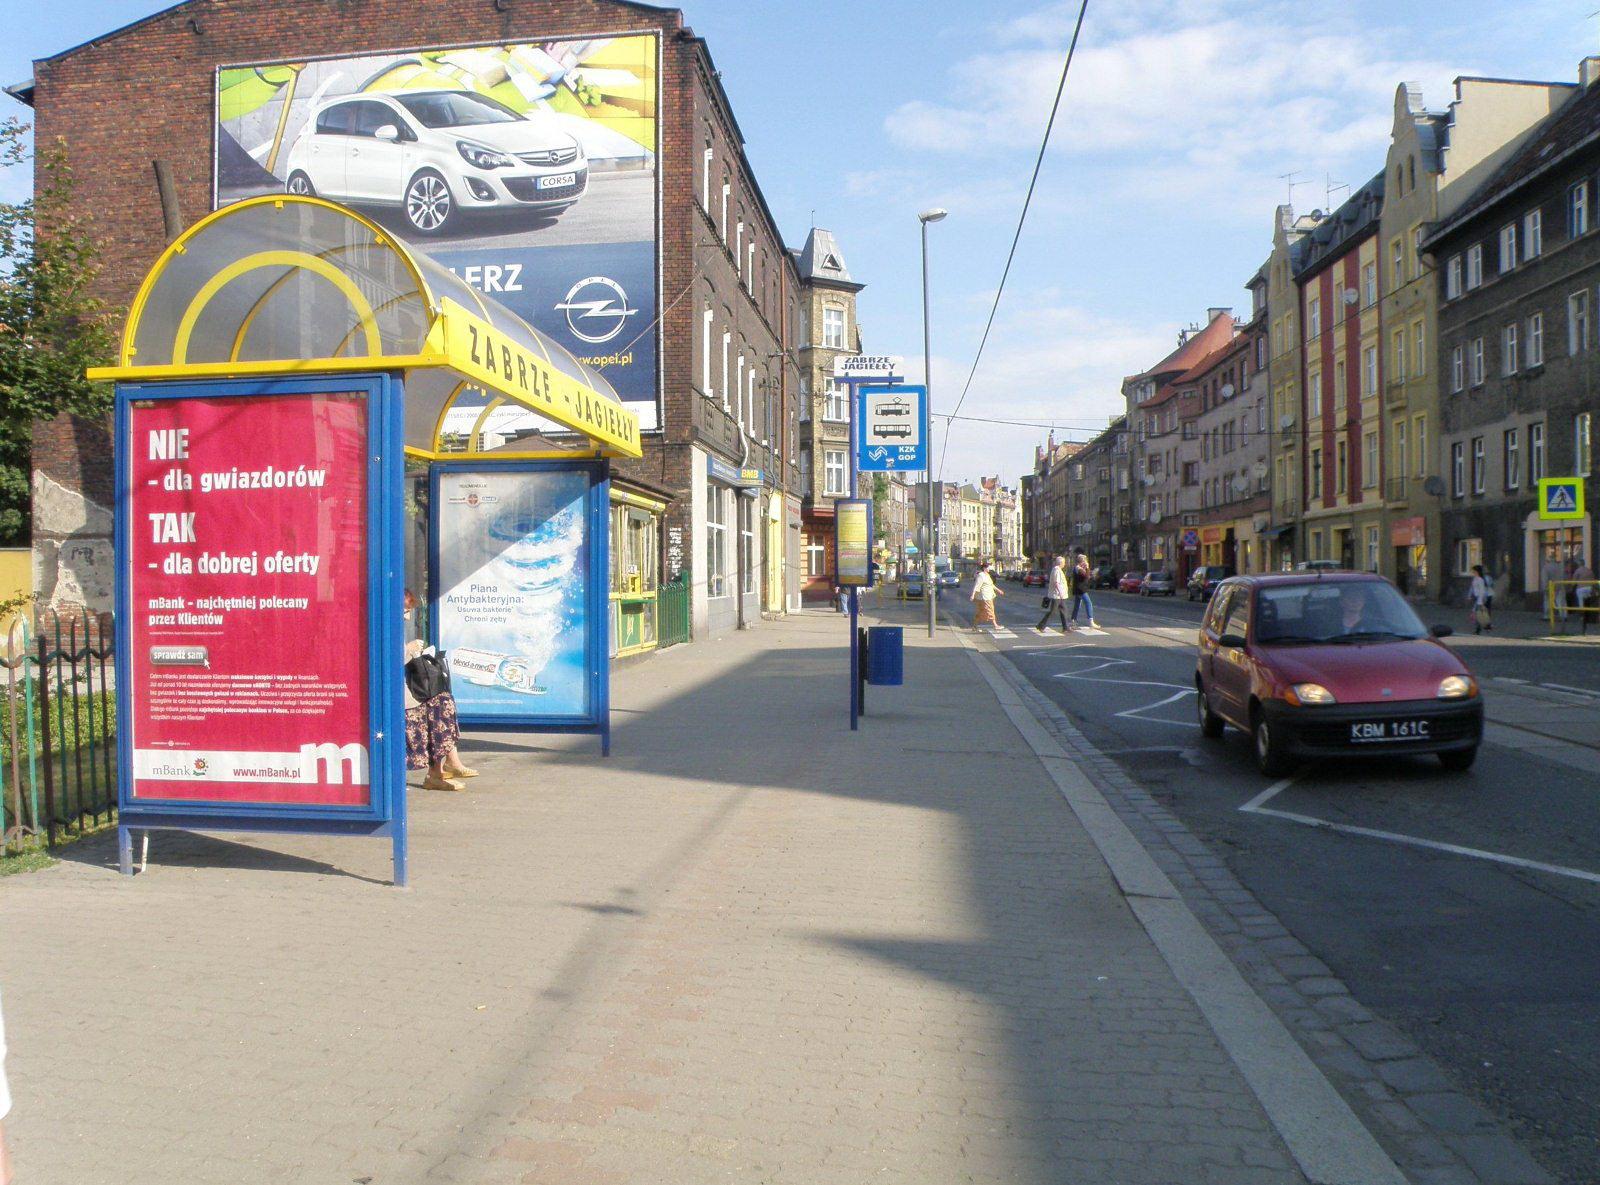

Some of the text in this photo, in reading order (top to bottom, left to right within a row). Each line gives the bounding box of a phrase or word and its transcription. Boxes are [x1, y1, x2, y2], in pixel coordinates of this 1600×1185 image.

[542, 176, 574, 187] CORSA
[449, 264, 523, 293] ERZ
[469, 324, 552, 404] ZABRZE
[578, 352, 632, 366] w.opel.pl
[149, 428, 189, 460] NIE
[163, 469, 193, 491] dla
[200, 465, 326, 492] gwiazdorów
[149, 512, 196, 543] TAK
[163, 552, 193, 574] dla
[198, 551, 258, 576] dobrej
[264, 551, 320, 576] oferty
[470, 584, 498, 593] Piana
[149, 597, 185, 609] mBank
[196, 596, 256, 611] najchętniej
[259, 596, 308, 609] polecany
[446, 595, 525, 605] Antybakteryjna:
[148, 612, 223, 626] przez Klientów
[153, 648, 204, 662] sprawdź sam
[1351, 720, 1429, 737] KBM 161C
[152, 764, 191, 776] mBank
[233, 767, 301, 779] www.mBank.pl
